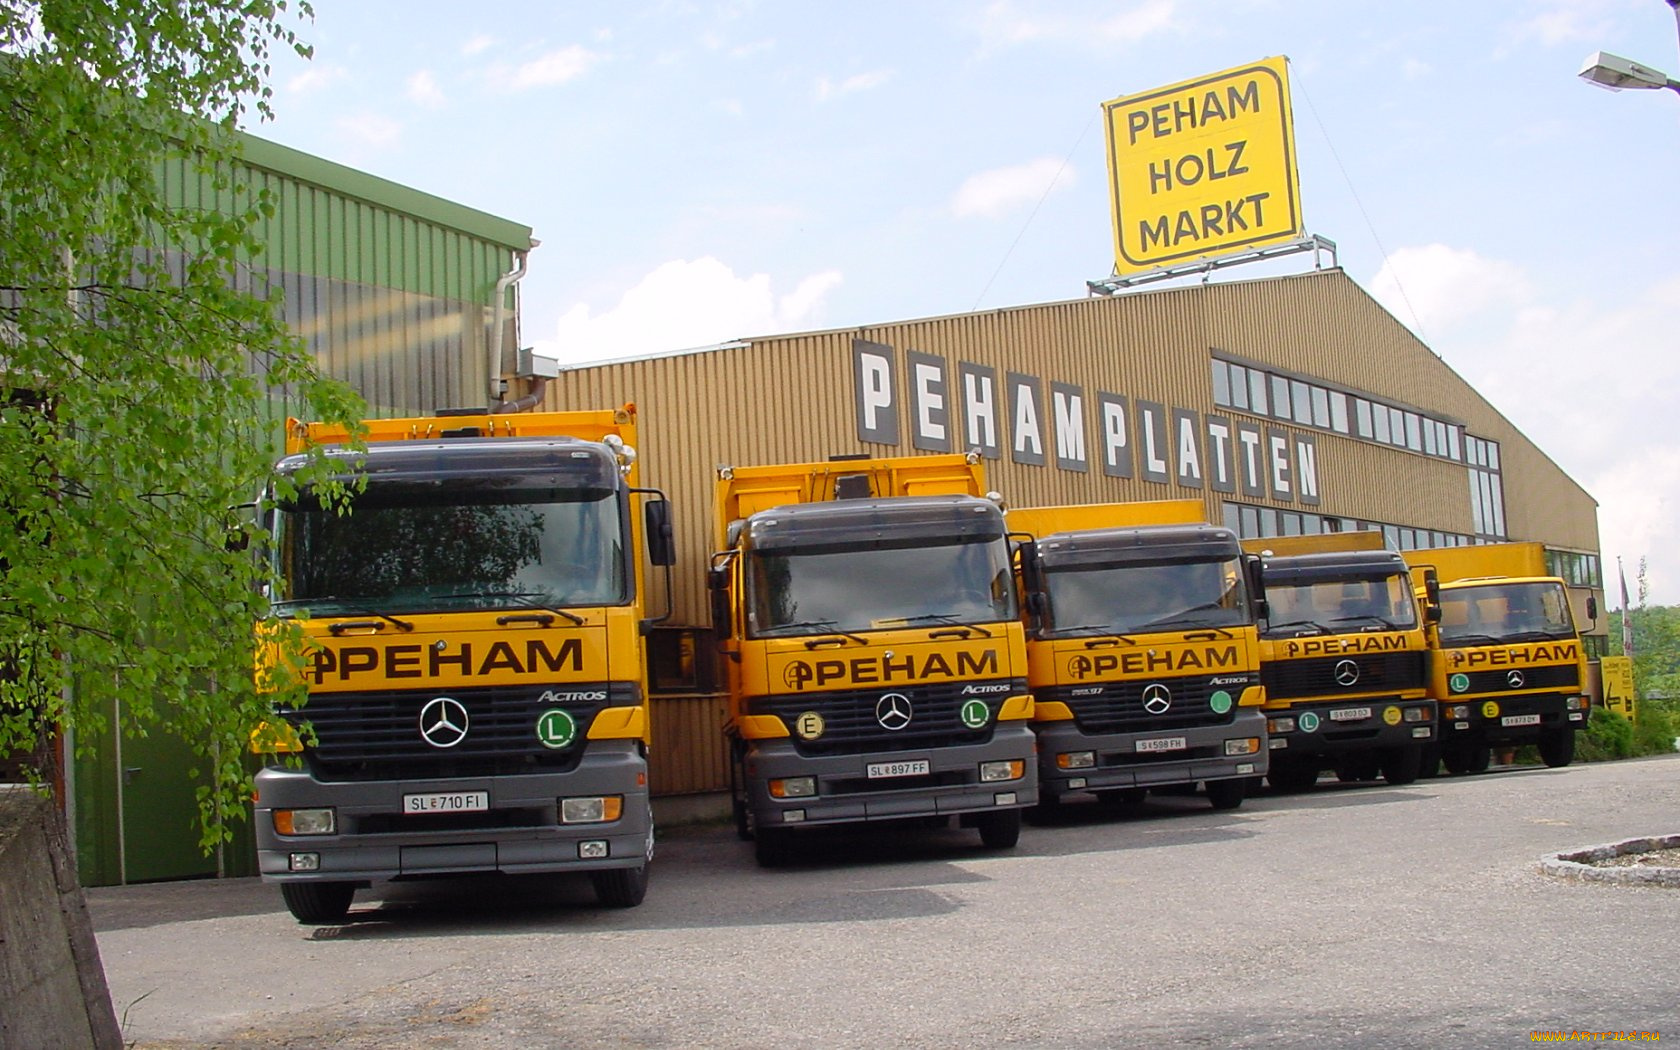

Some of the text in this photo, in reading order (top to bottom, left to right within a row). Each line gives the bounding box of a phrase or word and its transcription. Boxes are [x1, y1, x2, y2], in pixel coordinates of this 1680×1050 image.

[1128, 80, 1260, 146] PEHAM
[1149, 140, 1249, 194] HOLZ
[1139, 192, 1270, 253] MARKT
[1303, 635, 1407, 656] PEHAM
[1468, 644, 1577, 666] PEHAM
[339, 639, 583, 681] PEHAM
[816, 650, 998, 686] PEHAM
[1094, 646, 1237, 676] PEHAM
[1455, 677, 1464, 689] L
[969, 705, 981, 722] L
[1486, 704, 1495, 715] E
[548, 718, 563, 740] L
[804, 717, 815, 734] E
[1304, 716, 1314, 729] L
[870, 762, 925, 776] SL 897 FF
[411, 795, 479, 811] SL 710 FI
